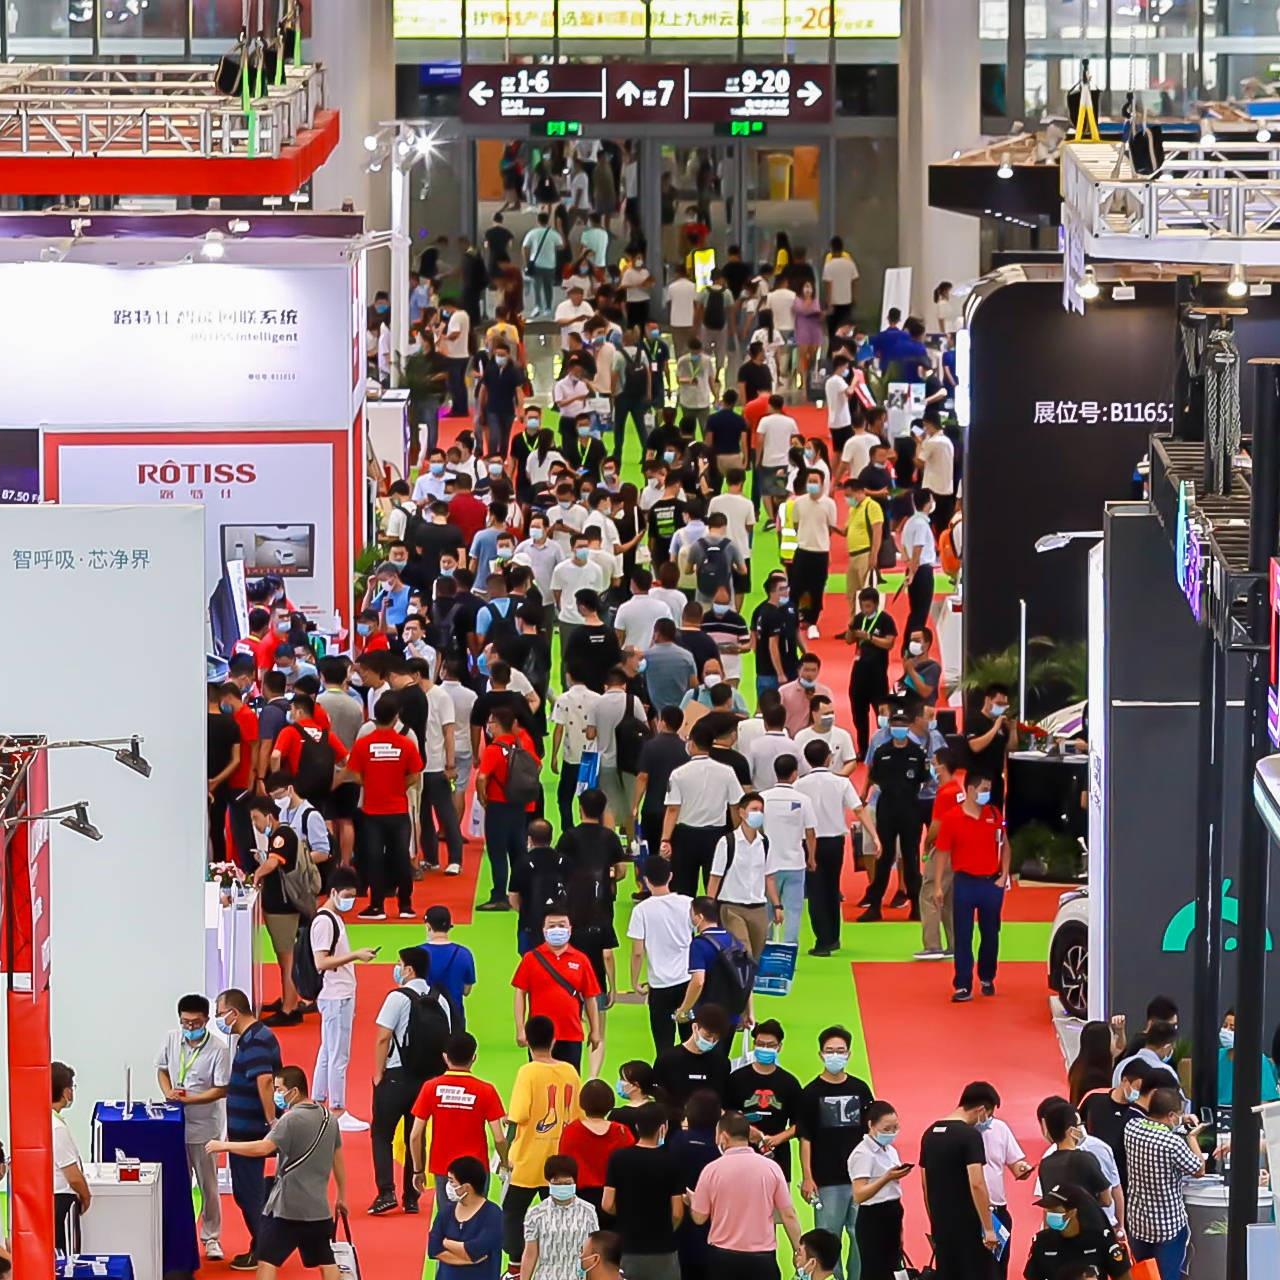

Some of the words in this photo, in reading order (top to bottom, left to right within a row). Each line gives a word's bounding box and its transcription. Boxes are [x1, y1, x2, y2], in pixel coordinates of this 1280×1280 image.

[657, 79, 676, 107] 7
[742, 69, 791, 93] 9-20
[137, 459, 258, 484] RÔTISS
[1, 489, 29, 502] 87.50
[11, 548, 151, 571] 智呼吸·芯净界
